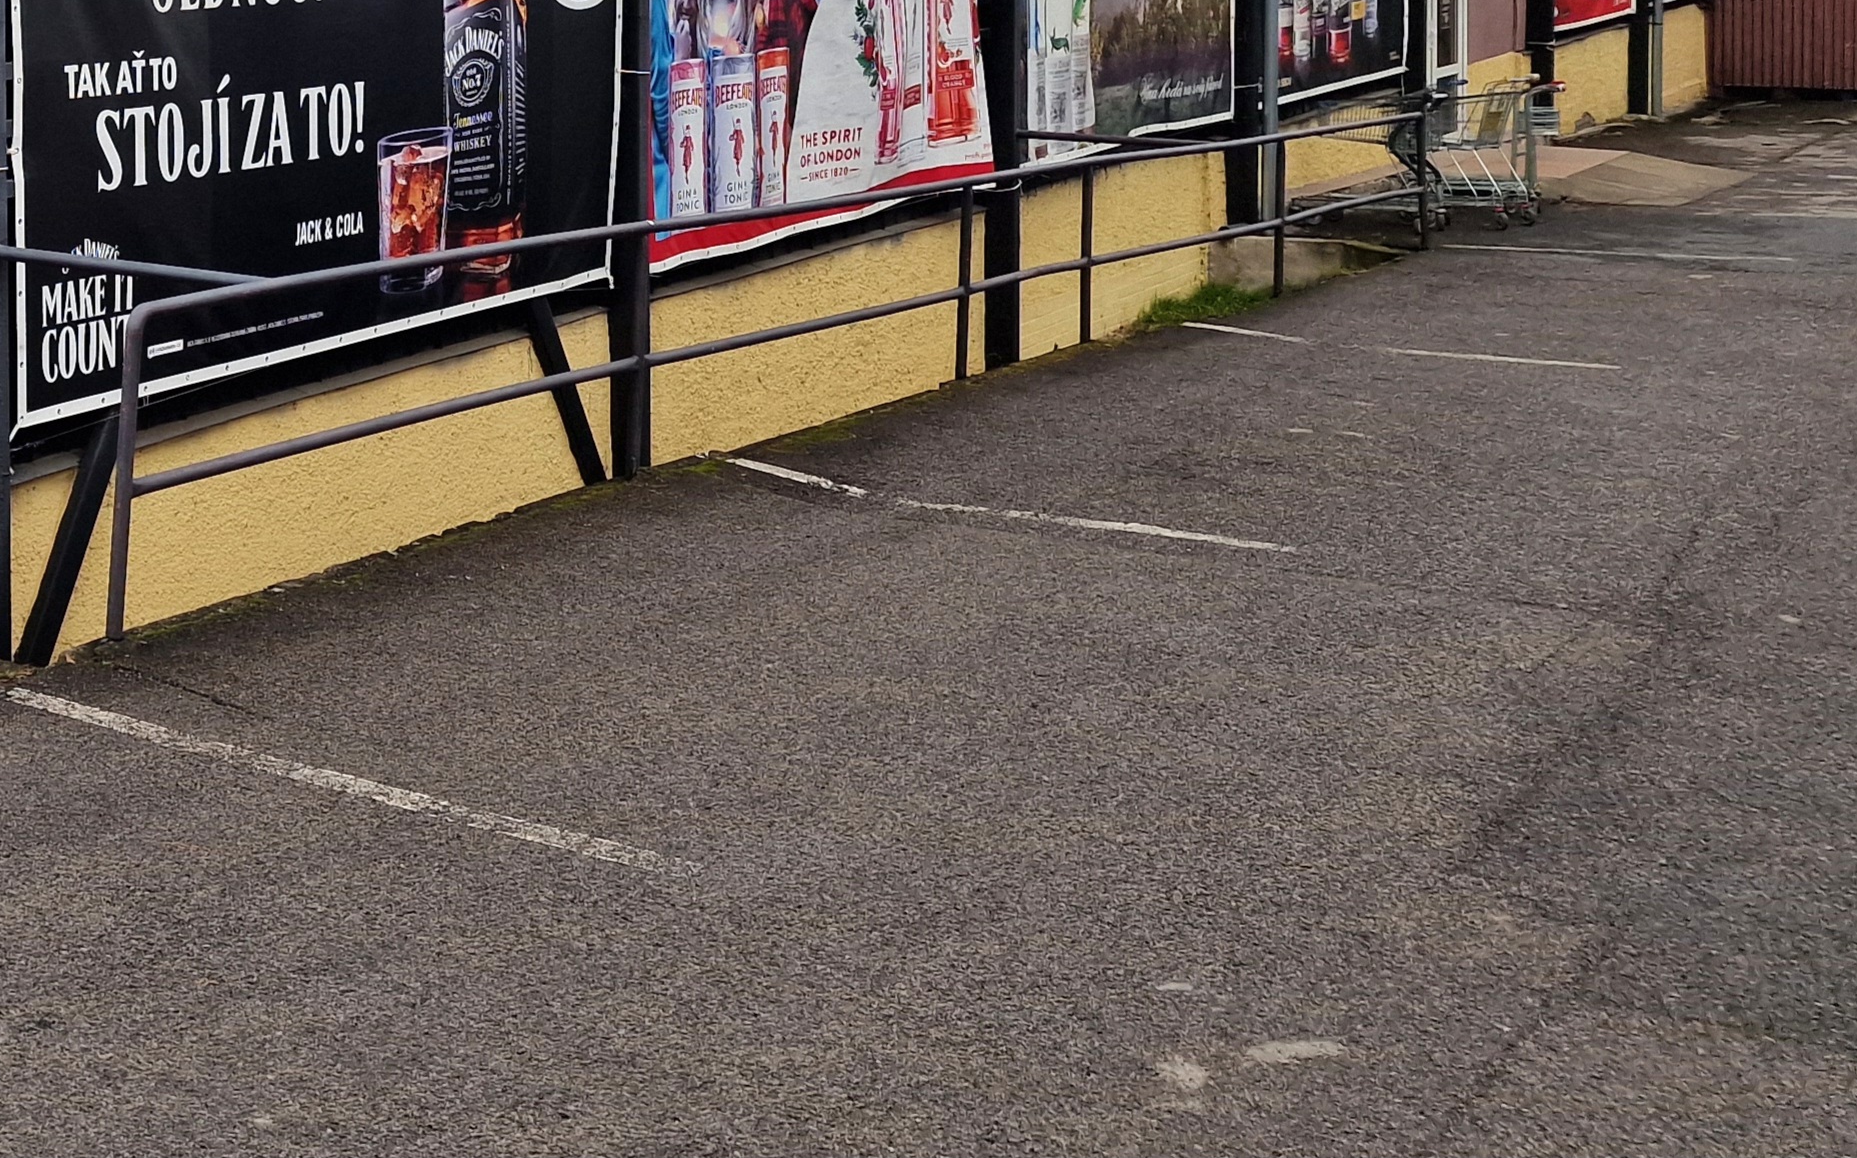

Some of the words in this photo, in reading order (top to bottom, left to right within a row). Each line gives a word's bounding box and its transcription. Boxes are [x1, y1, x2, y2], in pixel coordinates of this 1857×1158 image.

[64, 61, 111, 99] TAK
[115, 50, 146, 95] AŤ
[149, 56, 177, 91] TO
[453, 110, 493, 130] Tennessee
[96, 73, 231, 193] STOJÍ
[241, 91, 293, 170] ZA
[299, 81, 365, 161] TO!
[454, 134, 492, 152] WHISKEY
[800, 132, 818, 150] THE
[821, 127, 863, 146] SPIRIT
[800, 153, 812, 168] OF
[813, 147, 861, 166] LONDON
[808, 169, 829, 182] SINCE
[830, 166, 849, 178] 1820
[677, 189, 692, 201] GIN
[726, 181, 742, 193] GIN
[676, 199, 700, 213] TONIC
[295, 218, 322, 246] JACK
[325, 216, 333, 241] &
[336, 211, 364, 238] COLA
[42, 274, 107, 328] MAKE
